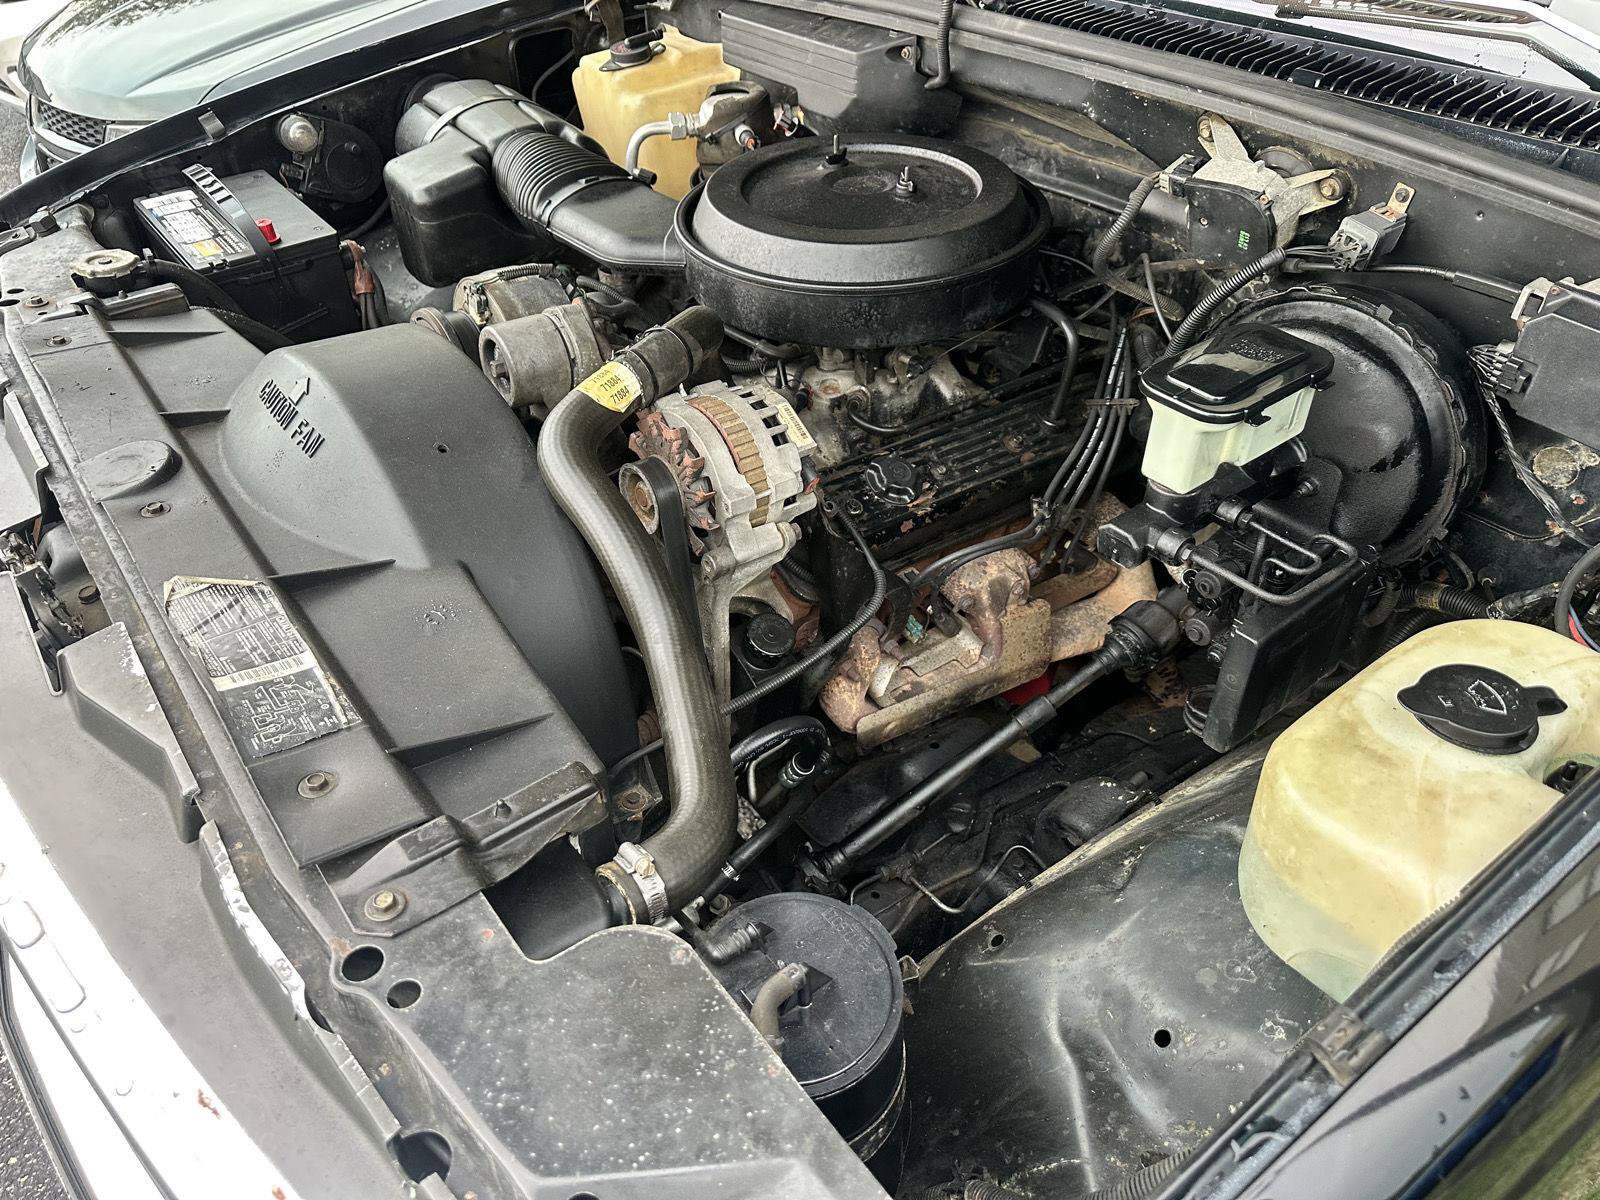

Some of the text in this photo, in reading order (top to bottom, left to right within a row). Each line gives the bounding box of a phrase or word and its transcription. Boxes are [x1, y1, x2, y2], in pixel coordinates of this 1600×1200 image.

[600, 374, 622, 392] 71884
[610, 385, 630, 404] 71884
[259, 379, 326, 459] CAUTION FAN
